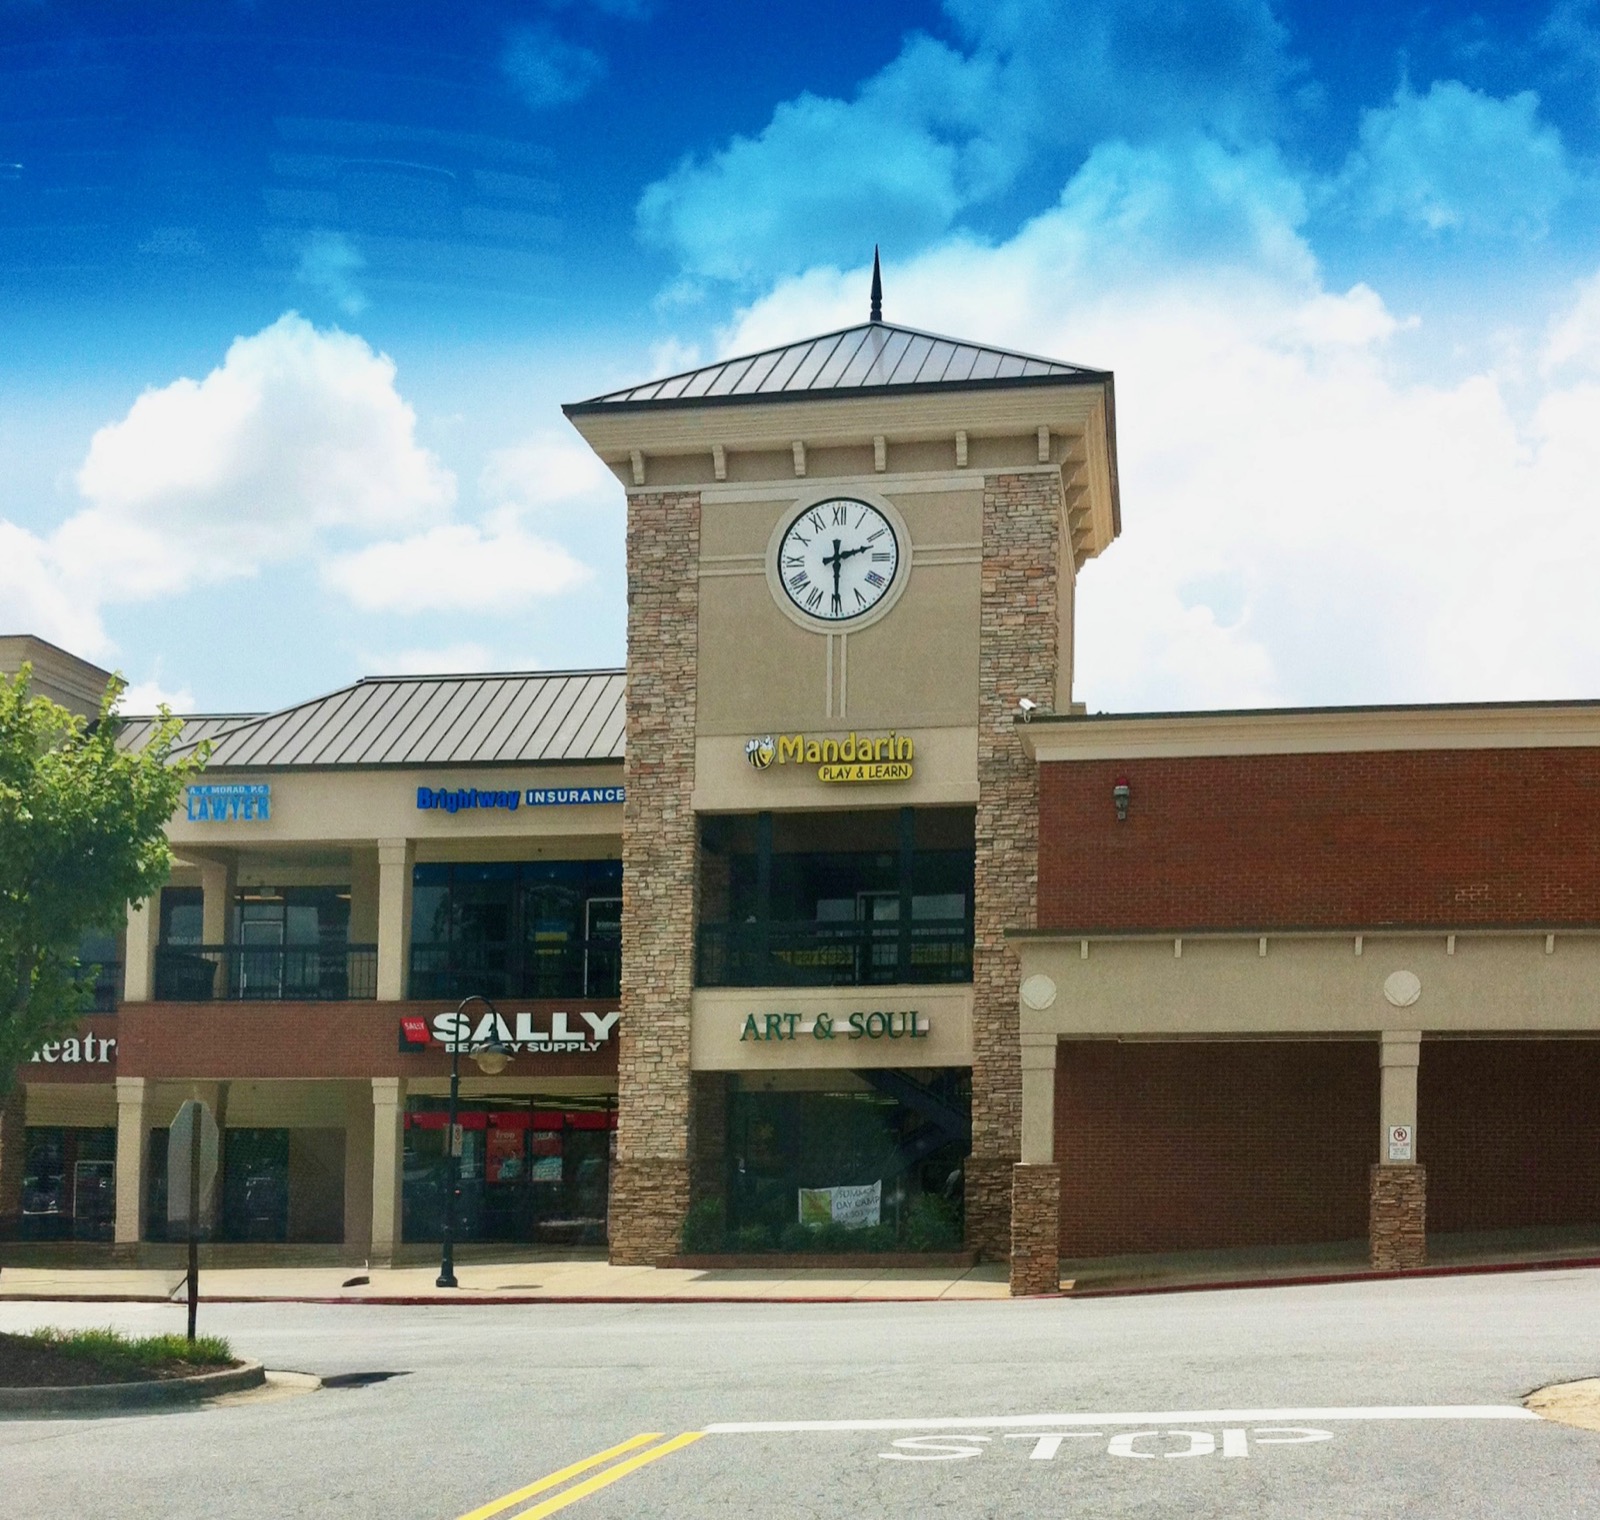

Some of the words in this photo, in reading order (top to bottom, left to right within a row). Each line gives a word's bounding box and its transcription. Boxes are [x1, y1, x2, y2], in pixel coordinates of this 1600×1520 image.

[778, 730, 914, 764] Mandarin
[823, 767, 852, 779] PLAY
[856, 767, 864, 778] &
[868, 765, 908, 778] LEARN
[187, 795, 270, 822] LAWYER
[417, 786, 520, 813] Brightway
[529, 789, 624, 803] INSURANCE
[432, 1011, 620, 1042] SALLY
[740, 1013, 802, 1042] ART
[812, 1012, 836, 1041] &
[848, 1011, 928, 1040] SOUL
[30, 1031, 119, 1063] eatr
[445, 1043, 522, 1053] BEY
[527, 1041, 601, 1053] SUPPLY
[836, 1201, 853, 1210] DAY
[855, 1195, 880, 1207] CAMP
[877, 1427, 1334, 1460] STOP
